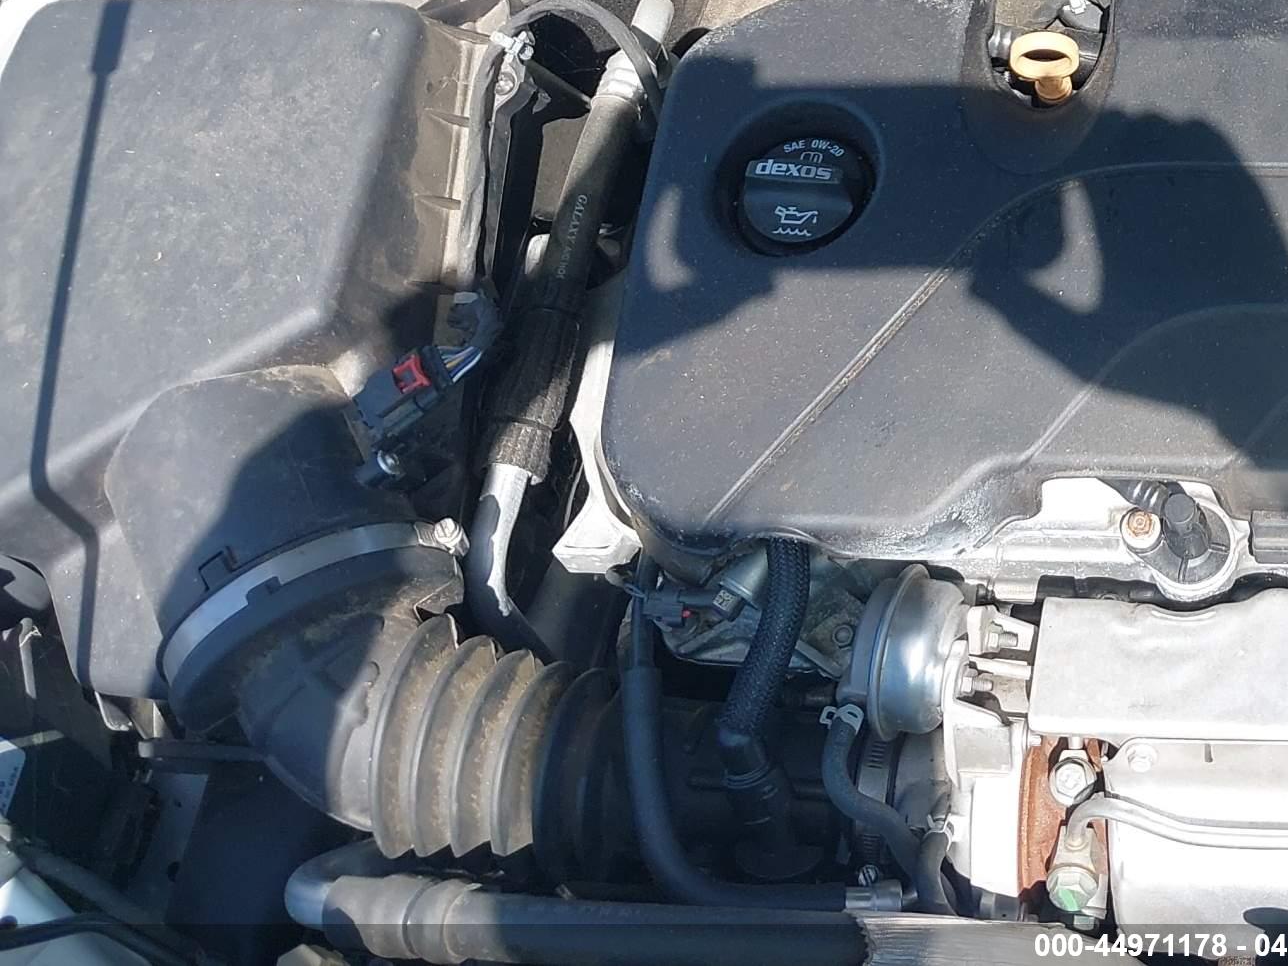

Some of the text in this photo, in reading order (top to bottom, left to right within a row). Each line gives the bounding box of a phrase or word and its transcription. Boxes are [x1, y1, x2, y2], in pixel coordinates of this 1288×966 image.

[783, 139, 845, 157] SAE 0W-20
[755, 159, 833, 180] dexos
